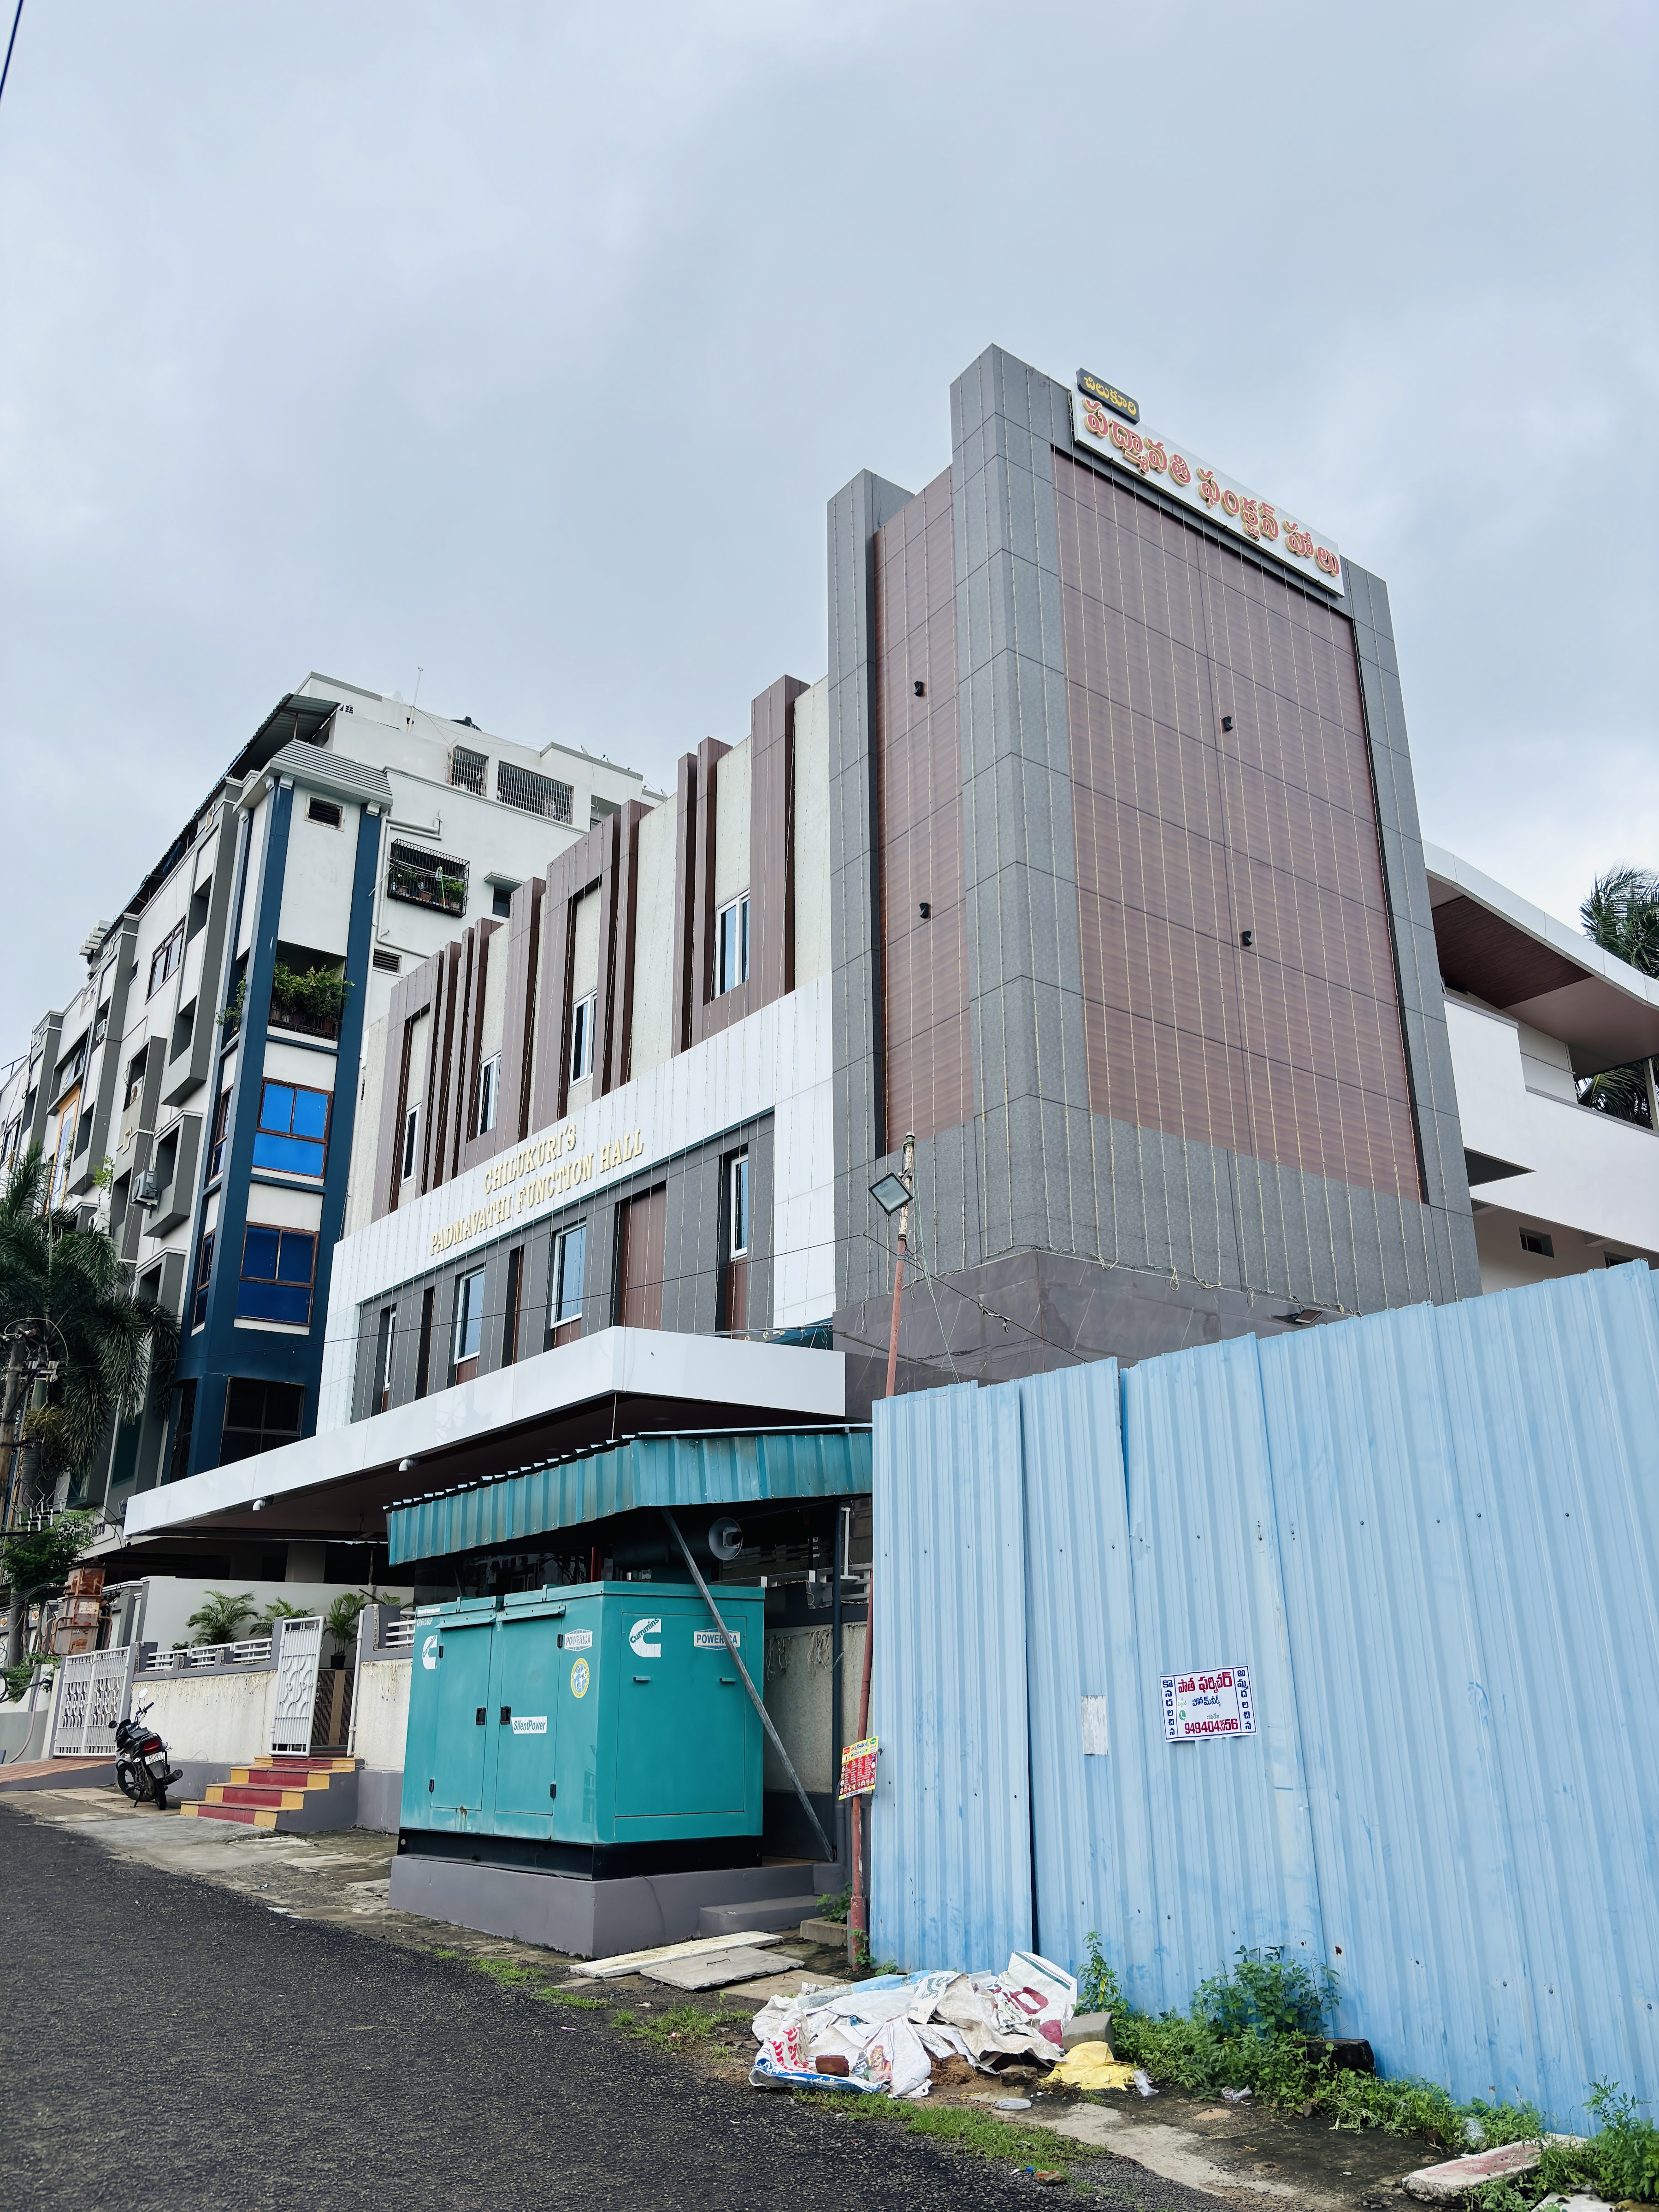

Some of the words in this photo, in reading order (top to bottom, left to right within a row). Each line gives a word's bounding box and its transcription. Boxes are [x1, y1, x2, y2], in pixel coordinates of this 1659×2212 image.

[1084, 377, 1136, 415] చిలుకూరి
[1081, 397, 1192, 487] పద్మావతి
[1282, 519, 1340, 578] హాలు
[430, 1194, 513, 1256] PADMAVATHI
[516, 1152, 594, 1214] FUNCTION
[599, 1129, 645, 1174] HALL
[566, 1634, 590, 1646] POWERICA
[630, 1618, 659, 1643] Cummins
[1178, 1677, 1196, 1693] పాత
[1198, 1672, 1233, 1693] ఫర్నిచర్
[514, 1720, 546, 1730] SilentPower
[1185, 1718, 1239, 1734] 9494043556
